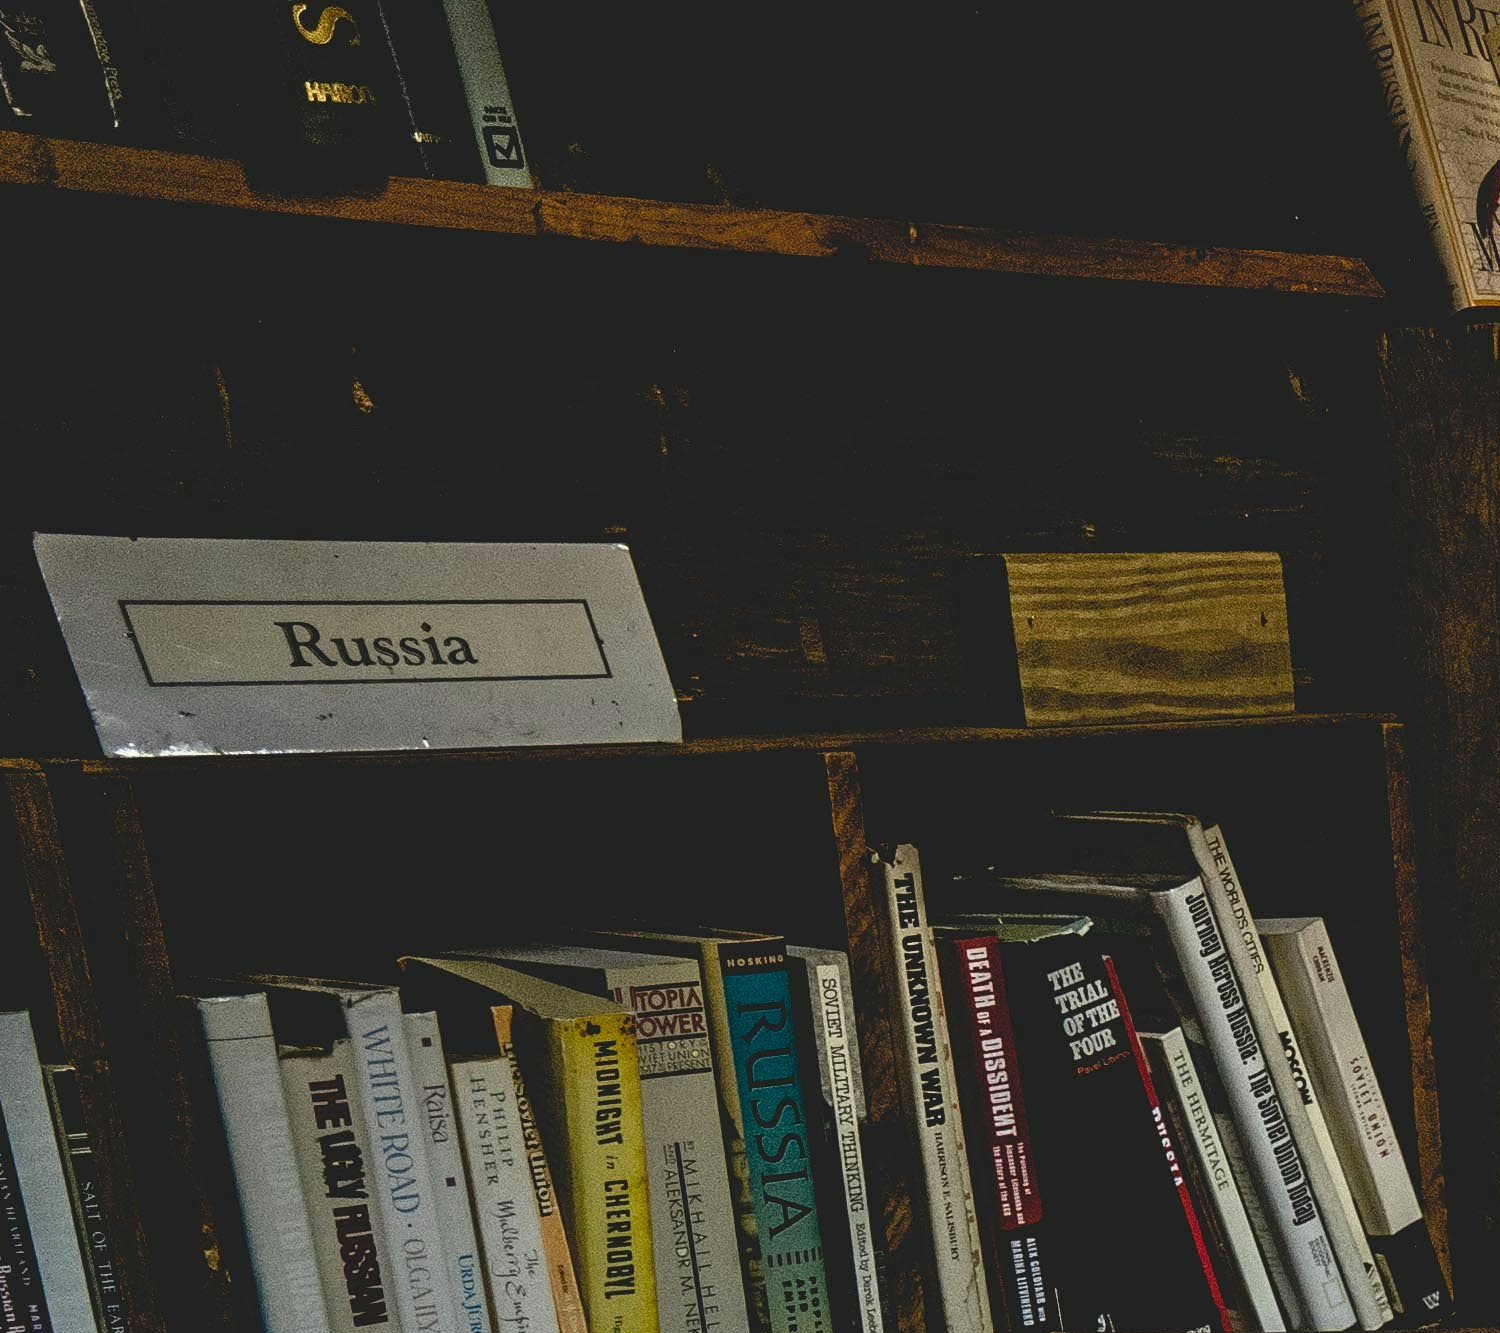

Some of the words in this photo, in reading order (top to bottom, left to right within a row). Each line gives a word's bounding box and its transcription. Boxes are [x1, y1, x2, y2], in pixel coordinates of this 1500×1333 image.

[275, 621, 478, 670] Russia
[894, 872, 919, 929] THE
[822, 978, 842, 1038] SOVIET
[903, 934, 937, 1063] UNKNOWN
[1048, 962, 1084, 991] THE
[1055, 979, 1109, 1013] TRIAL
[966, 947, 996, 1008] DEATH
[983, 1037, 1018, 1137] DISSIDENT
[1062, 1013, 1087, 1041] OF
[1085, 999, 1121, 1027] THE
[1069, 1028, 1117, 1060] FOUR
[362, 1025, 407, 1141] WHITE
[595, 1040, 624, 1146] MIDNIGHT
[738, 997, 812, 1242] RUSSIA
[829, 1045, 855, 1137] MILITARY
[921, 1069, 945, 1127] WAR
[309, 1075, 353, 1130] THE
[333, 1204, 388, 1328] RUSSIAN
[381, 1134, 420, 1215] ROAD
[841, 1140, 865, 1215] THINKING
[604, 1179, 636, 1301] CHERNOBYL
